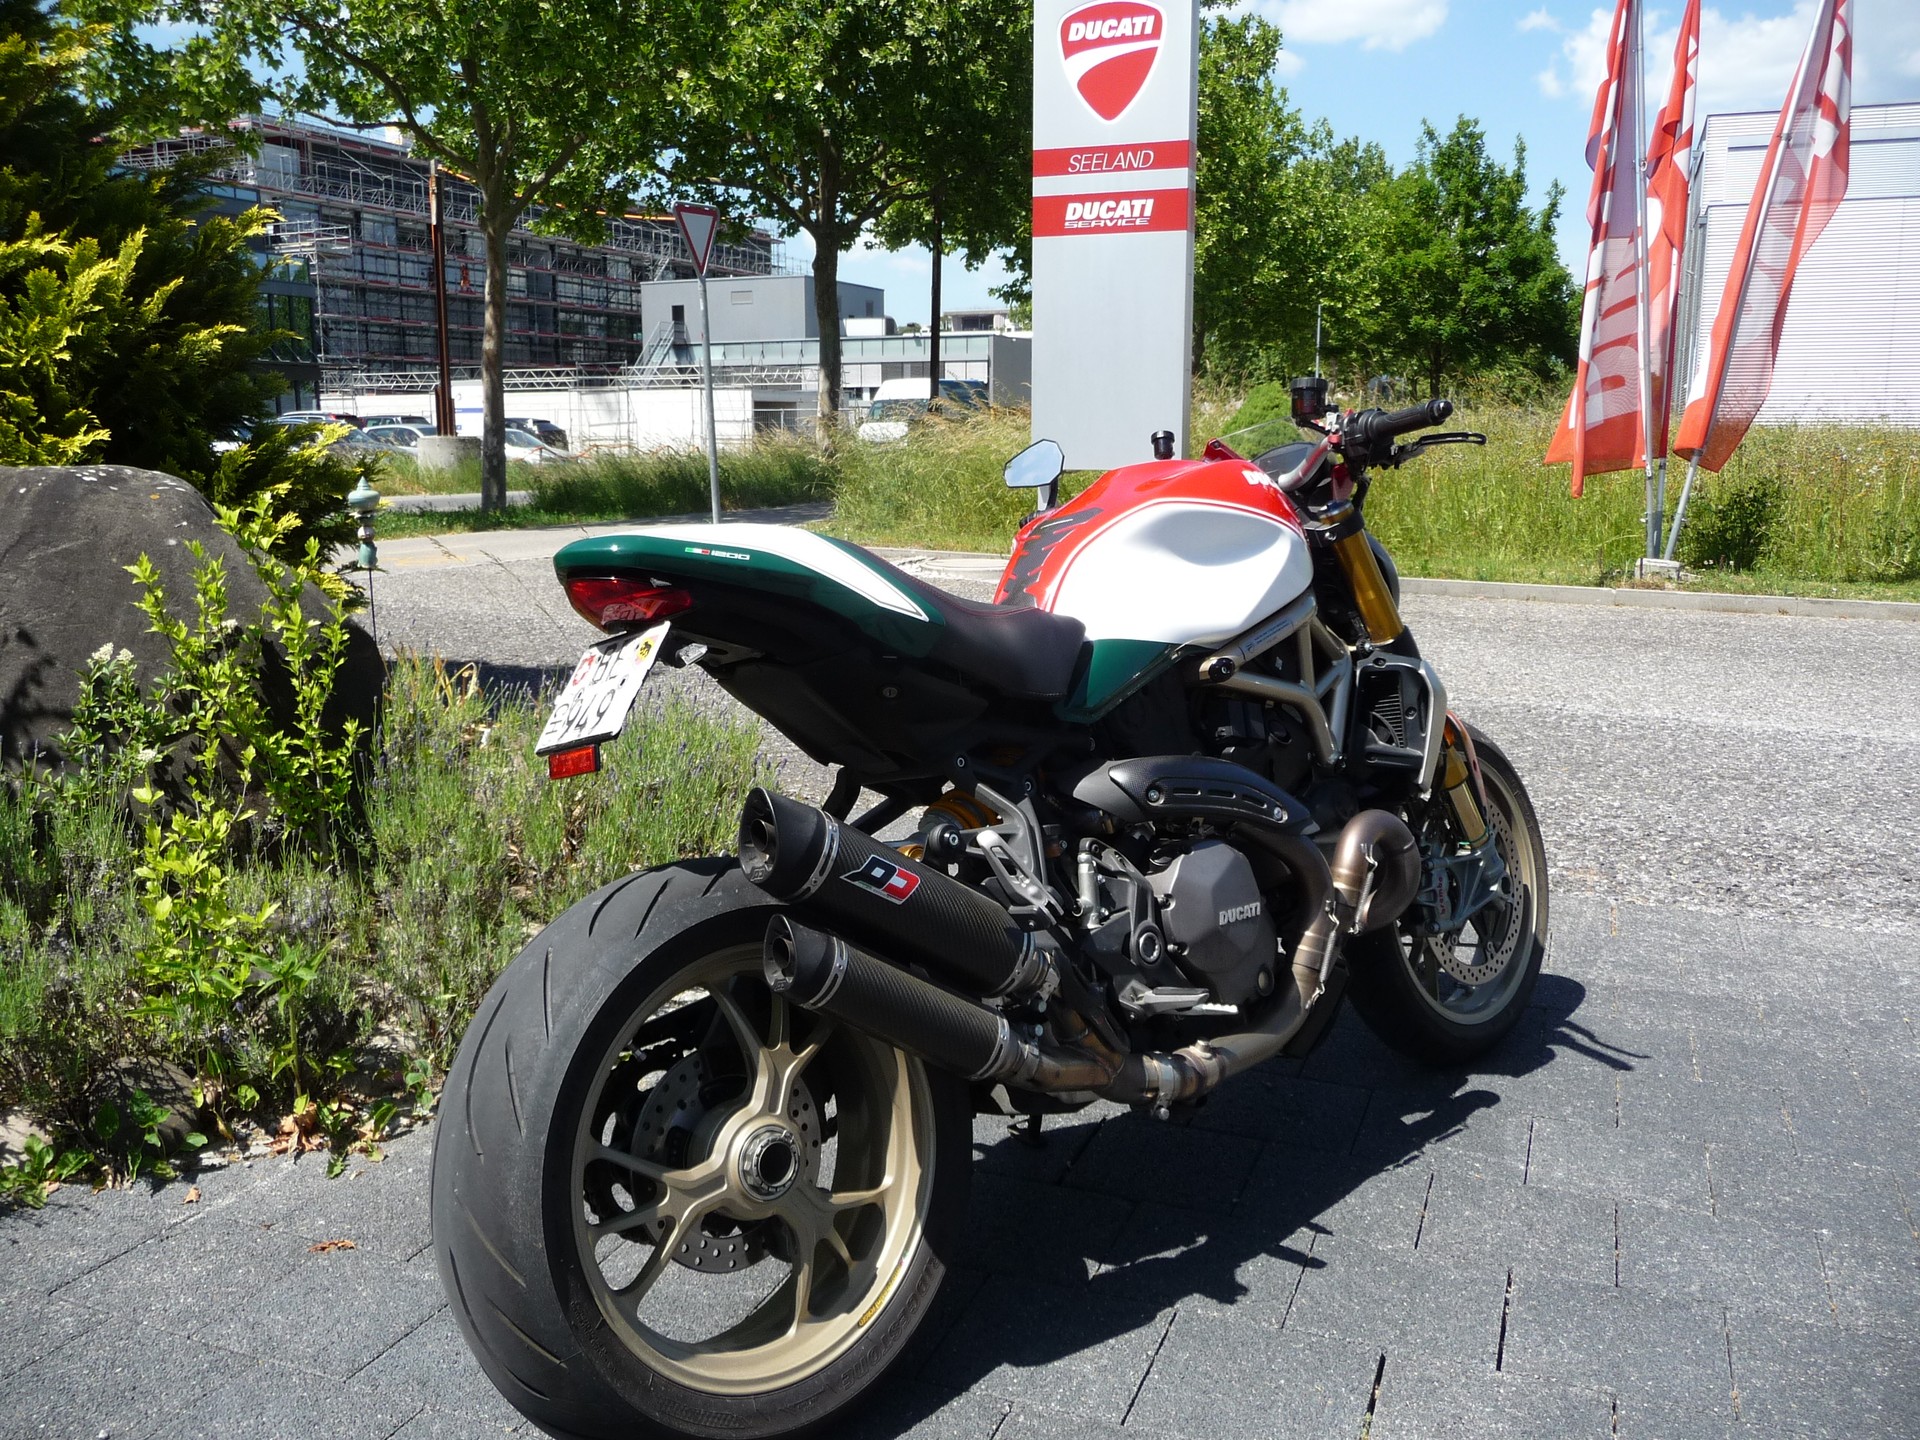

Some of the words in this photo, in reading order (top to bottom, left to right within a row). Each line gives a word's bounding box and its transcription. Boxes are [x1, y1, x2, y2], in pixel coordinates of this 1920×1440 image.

[1068, 15, 1155, 41] DUCATI
[1068, 150, 1154, 173] SEELAND
[1065, 199, 1154, 220] DUCATI
[1064, 217, 1149, 229] SERVICE
[711, 550, 750, 561] 1200
[1219, 902, 1260, 926] DUCATI
